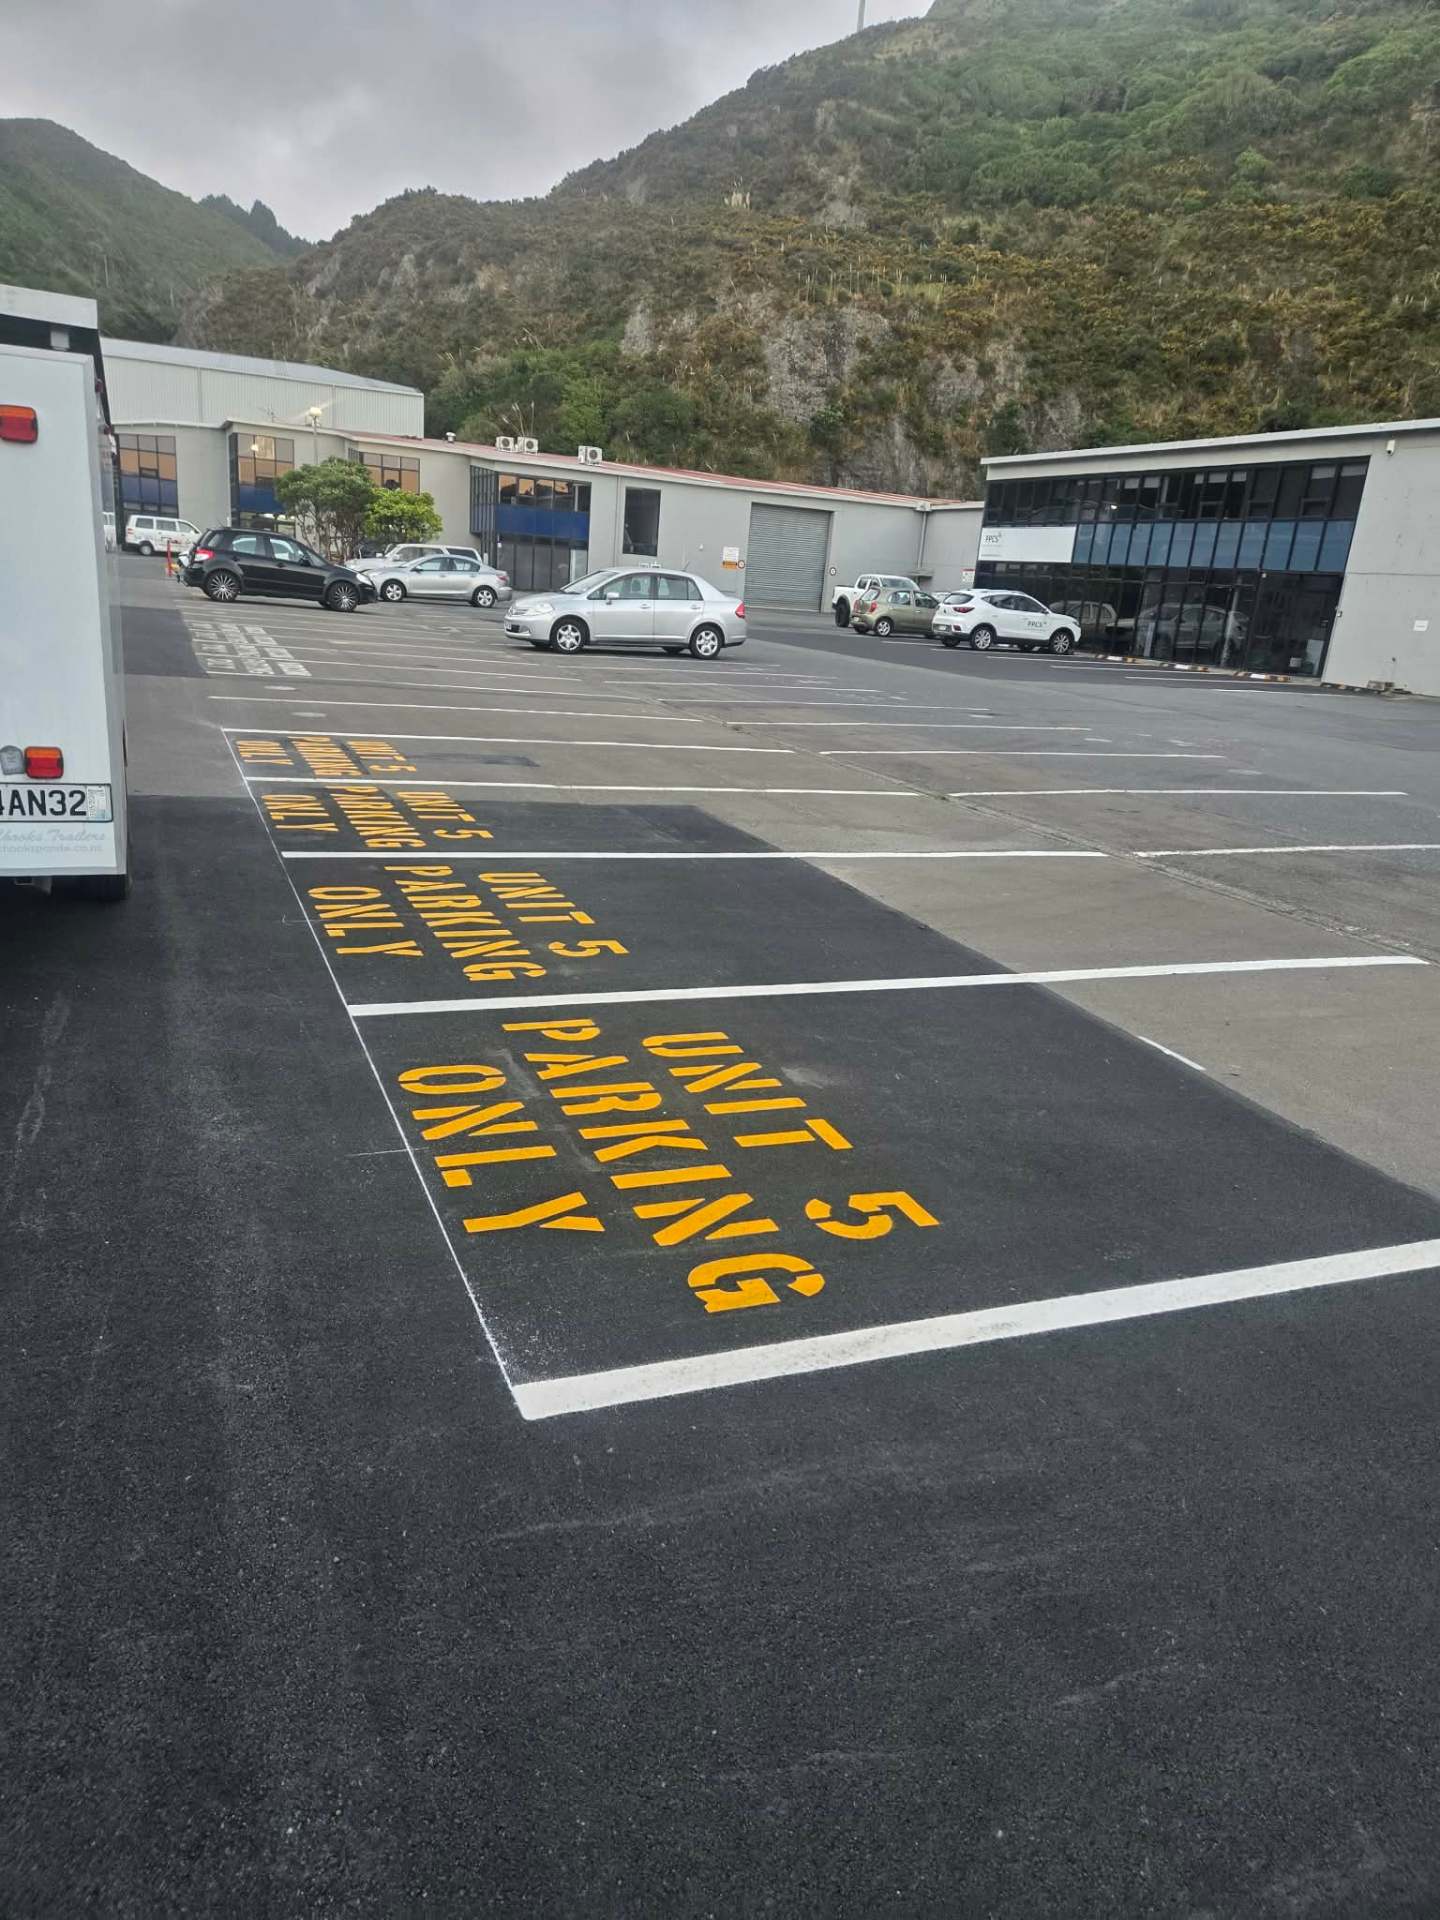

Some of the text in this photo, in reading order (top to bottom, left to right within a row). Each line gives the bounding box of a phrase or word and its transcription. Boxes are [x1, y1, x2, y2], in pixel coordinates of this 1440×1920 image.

[235, 740, 295, 766] ONLY
[287, 736, 364, 777] PARKING
[347, 740, 417, 773] UNIT 5
[261, 794, 340, 833] ONLY
[325, 786, 427, 848] PARKING
[396, 791, 494, 840] UNIT 5
[308, 885, 425, 957] ONLY
[384, 865, 548, 982] PARKING
[480, 871, 631, 959] UNIT 5
[397, 1064, 606, 1234] ONLY
[502, 1017, 827, 1314] PARKING
[641, 1031, 942, 1241] UNIT 5
